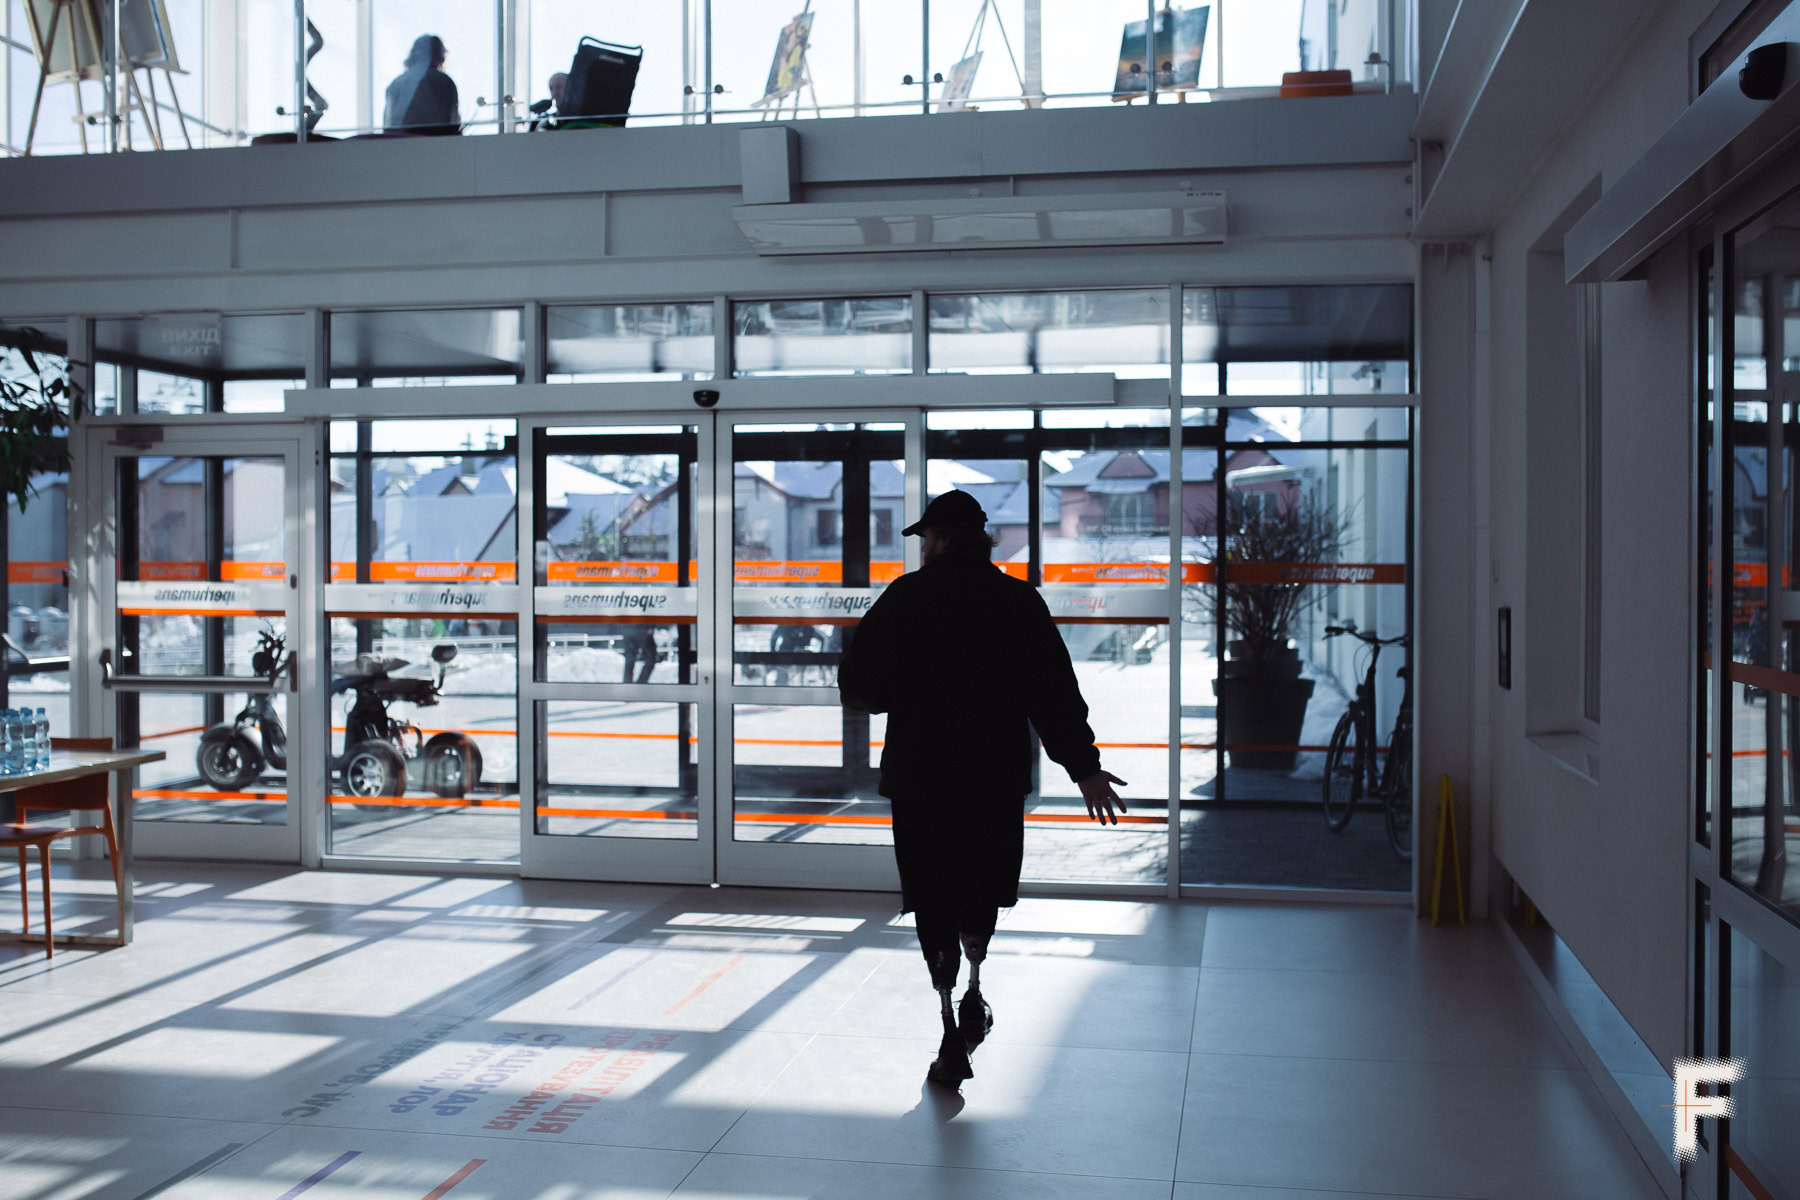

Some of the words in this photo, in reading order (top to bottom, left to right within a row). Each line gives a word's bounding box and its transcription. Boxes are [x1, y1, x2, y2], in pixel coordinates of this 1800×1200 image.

[281, 1092, 352, 1118] WC
[387, 1086, 443, 1114] ЛОР
[431, 1033, 567, 1116] СТАЦІОНАР
[482, 1031, 637, 1130] ПРОТЕЗУВАННЯ
[527, 1033, 678, 1134] РЕАБІЛІТАЦІЯ
